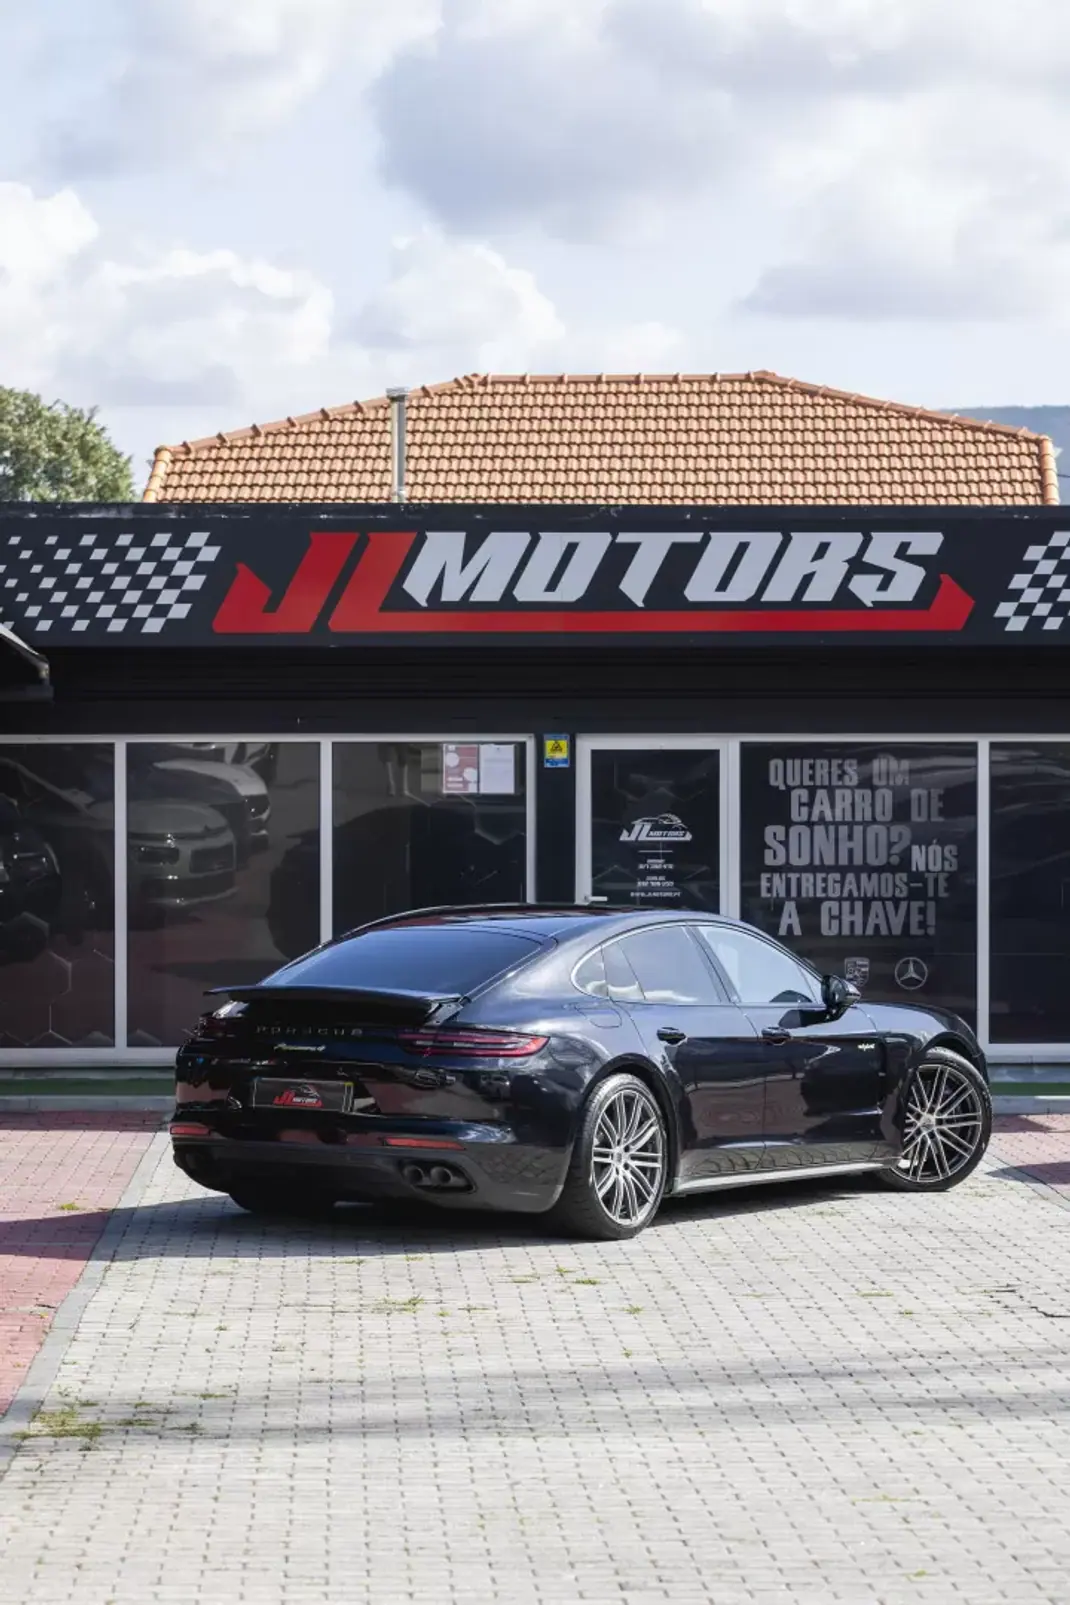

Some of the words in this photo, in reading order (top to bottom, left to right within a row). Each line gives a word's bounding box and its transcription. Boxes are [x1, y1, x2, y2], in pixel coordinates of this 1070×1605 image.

[769, 758, 859, 790] QUERES
[872, 758, 909, 786] UM
[790, 788, 893, 822] CARRO
[910, 788, 944, 822] DE
[764, 825, 912, 866] SONHO?
[911, 838, 958, 872] NÓS
[760, 872, 949, 898] ENTREGAMOS-TE
[778, 901, 802, 936] A
[820, 901, 936, 936] CHAVE!
